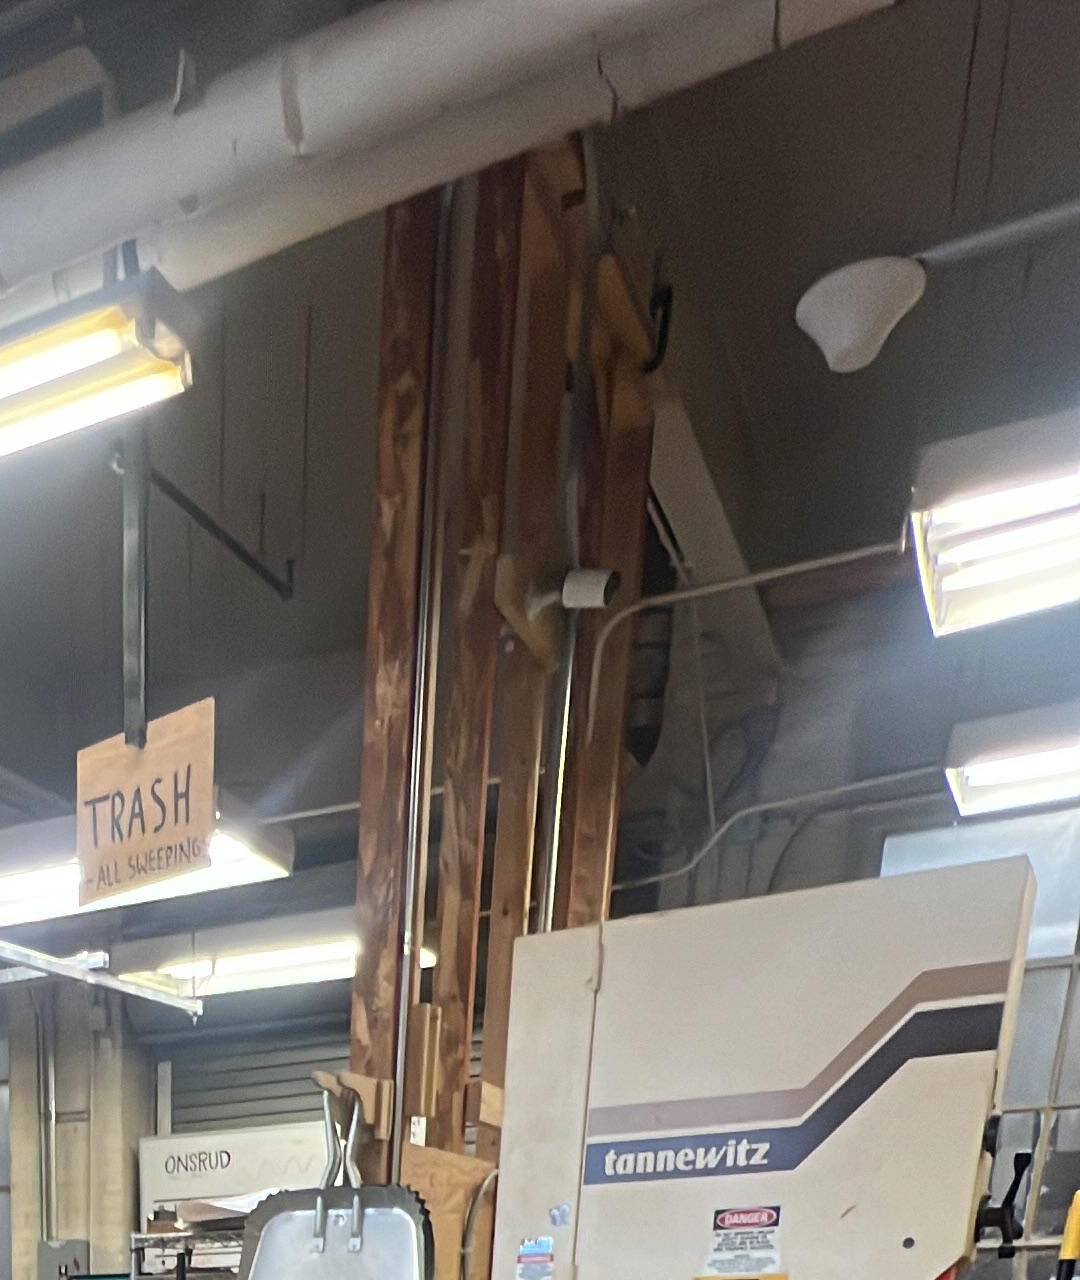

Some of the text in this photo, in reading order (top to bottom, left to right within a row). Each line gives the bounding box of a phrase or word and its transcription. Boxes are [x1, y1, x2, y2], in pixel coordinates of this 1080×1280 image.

[84, 764, 191, 848] TRASH
[165, 1150, 231, 1174] ONSRUD
[605, 1138, 770, 1176] tannewitz
[724, 1212, 768, 1225] DANGER
